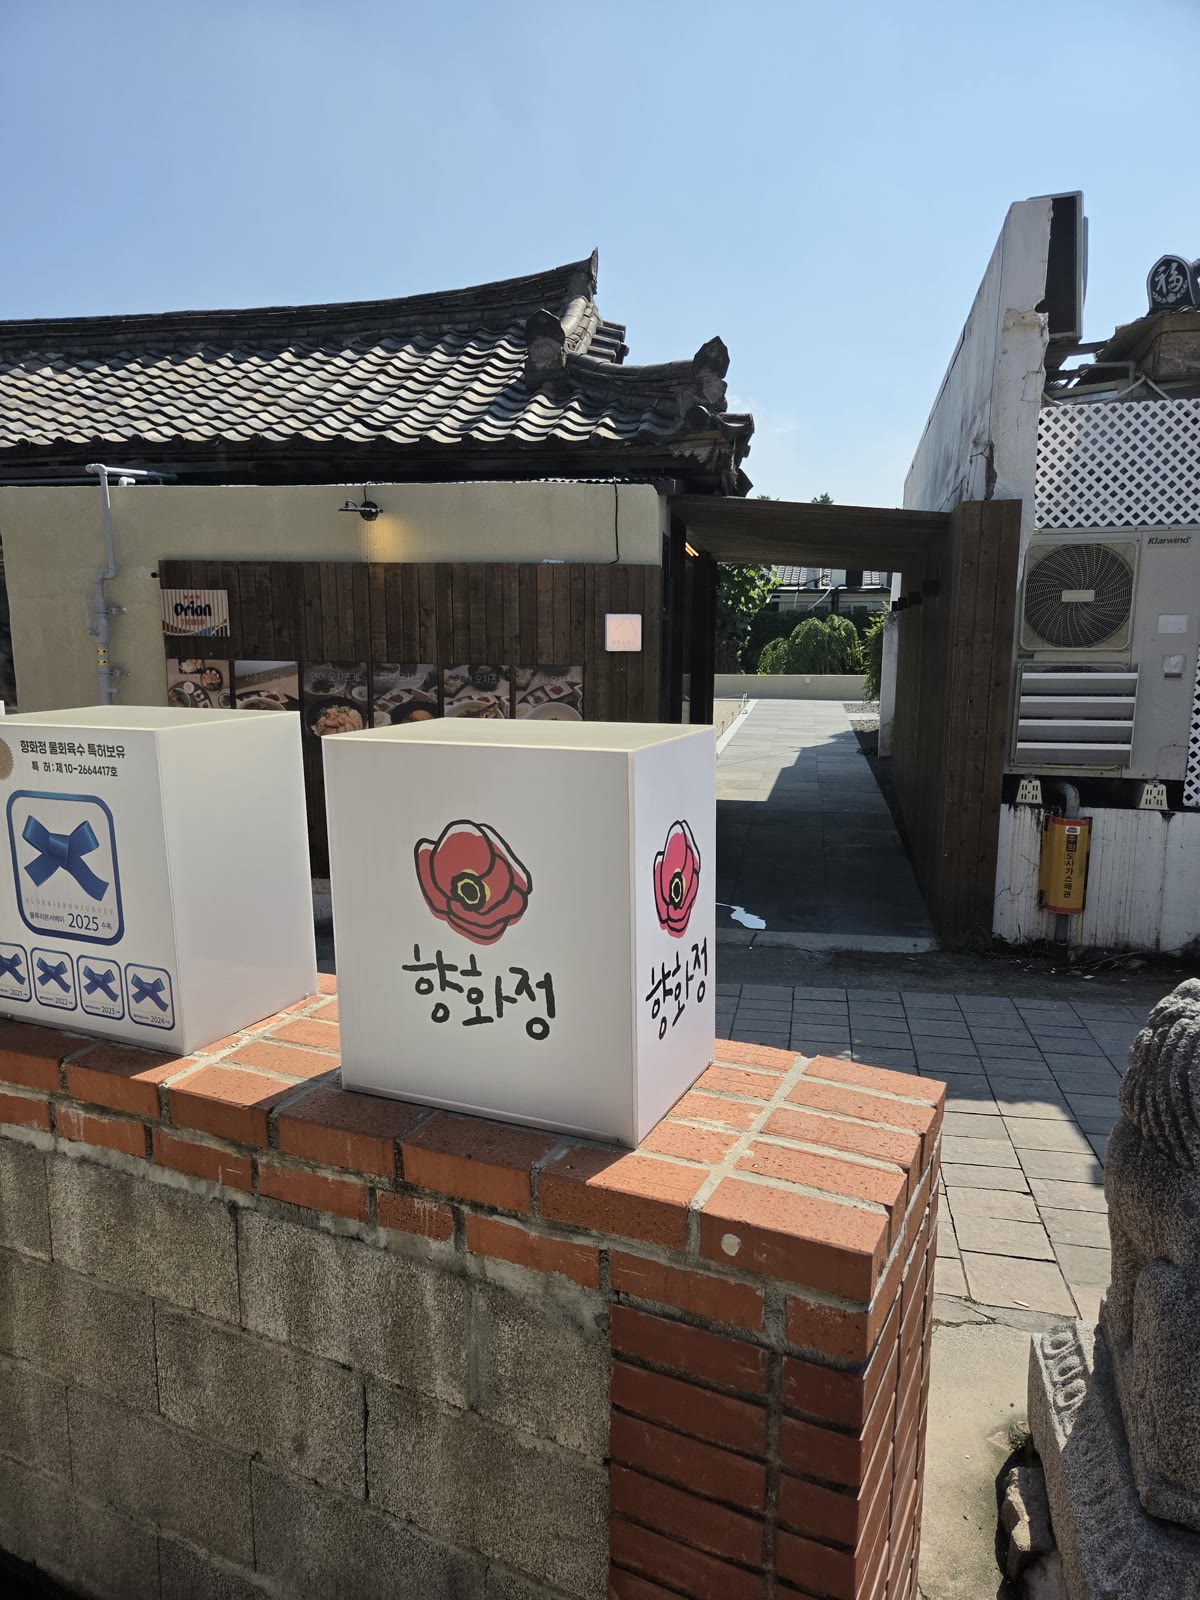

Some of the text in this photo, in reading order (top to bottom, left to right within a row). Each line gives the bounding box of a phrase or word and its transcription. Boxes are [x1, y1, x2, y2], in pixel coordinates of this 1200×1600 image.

[1155, 263, 1184, 294] 福
[20, 740, 126, 759] 향화정 물회육수 특허보유
[1066, 835, 1078, 852] 주의
[1063, 852, 1076, 899] 도시가스배관
[67, 912, 99, 932] 2025
[402, 944, 556, 1040] 향화정
[645, 937, 708, 1040] 향화정
[54, 996, 68, 1006] 2022
[101, 1005, 115, 1015] 2023
[150, 1015, 165, 1025] 2024
